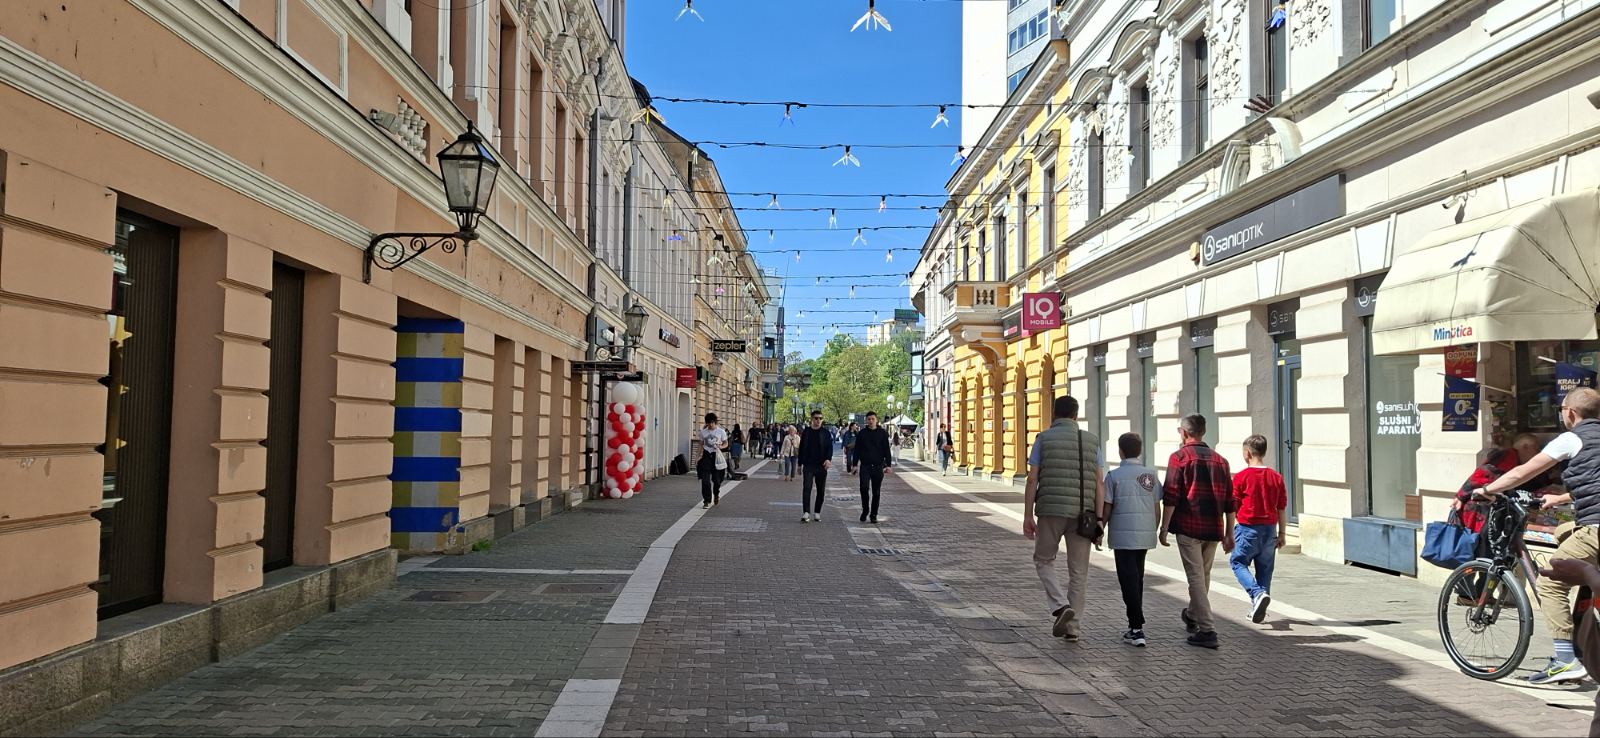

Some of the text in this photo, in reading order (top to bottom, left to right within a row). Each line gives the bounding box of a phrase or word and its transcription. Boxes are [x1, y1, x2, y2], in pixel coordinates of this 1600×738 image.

[1029, 297, 1054, 319] IQ
[1379, 414, 1411, 425] SLUŠNI
[1377, 426, 1415, 435] APARATI
